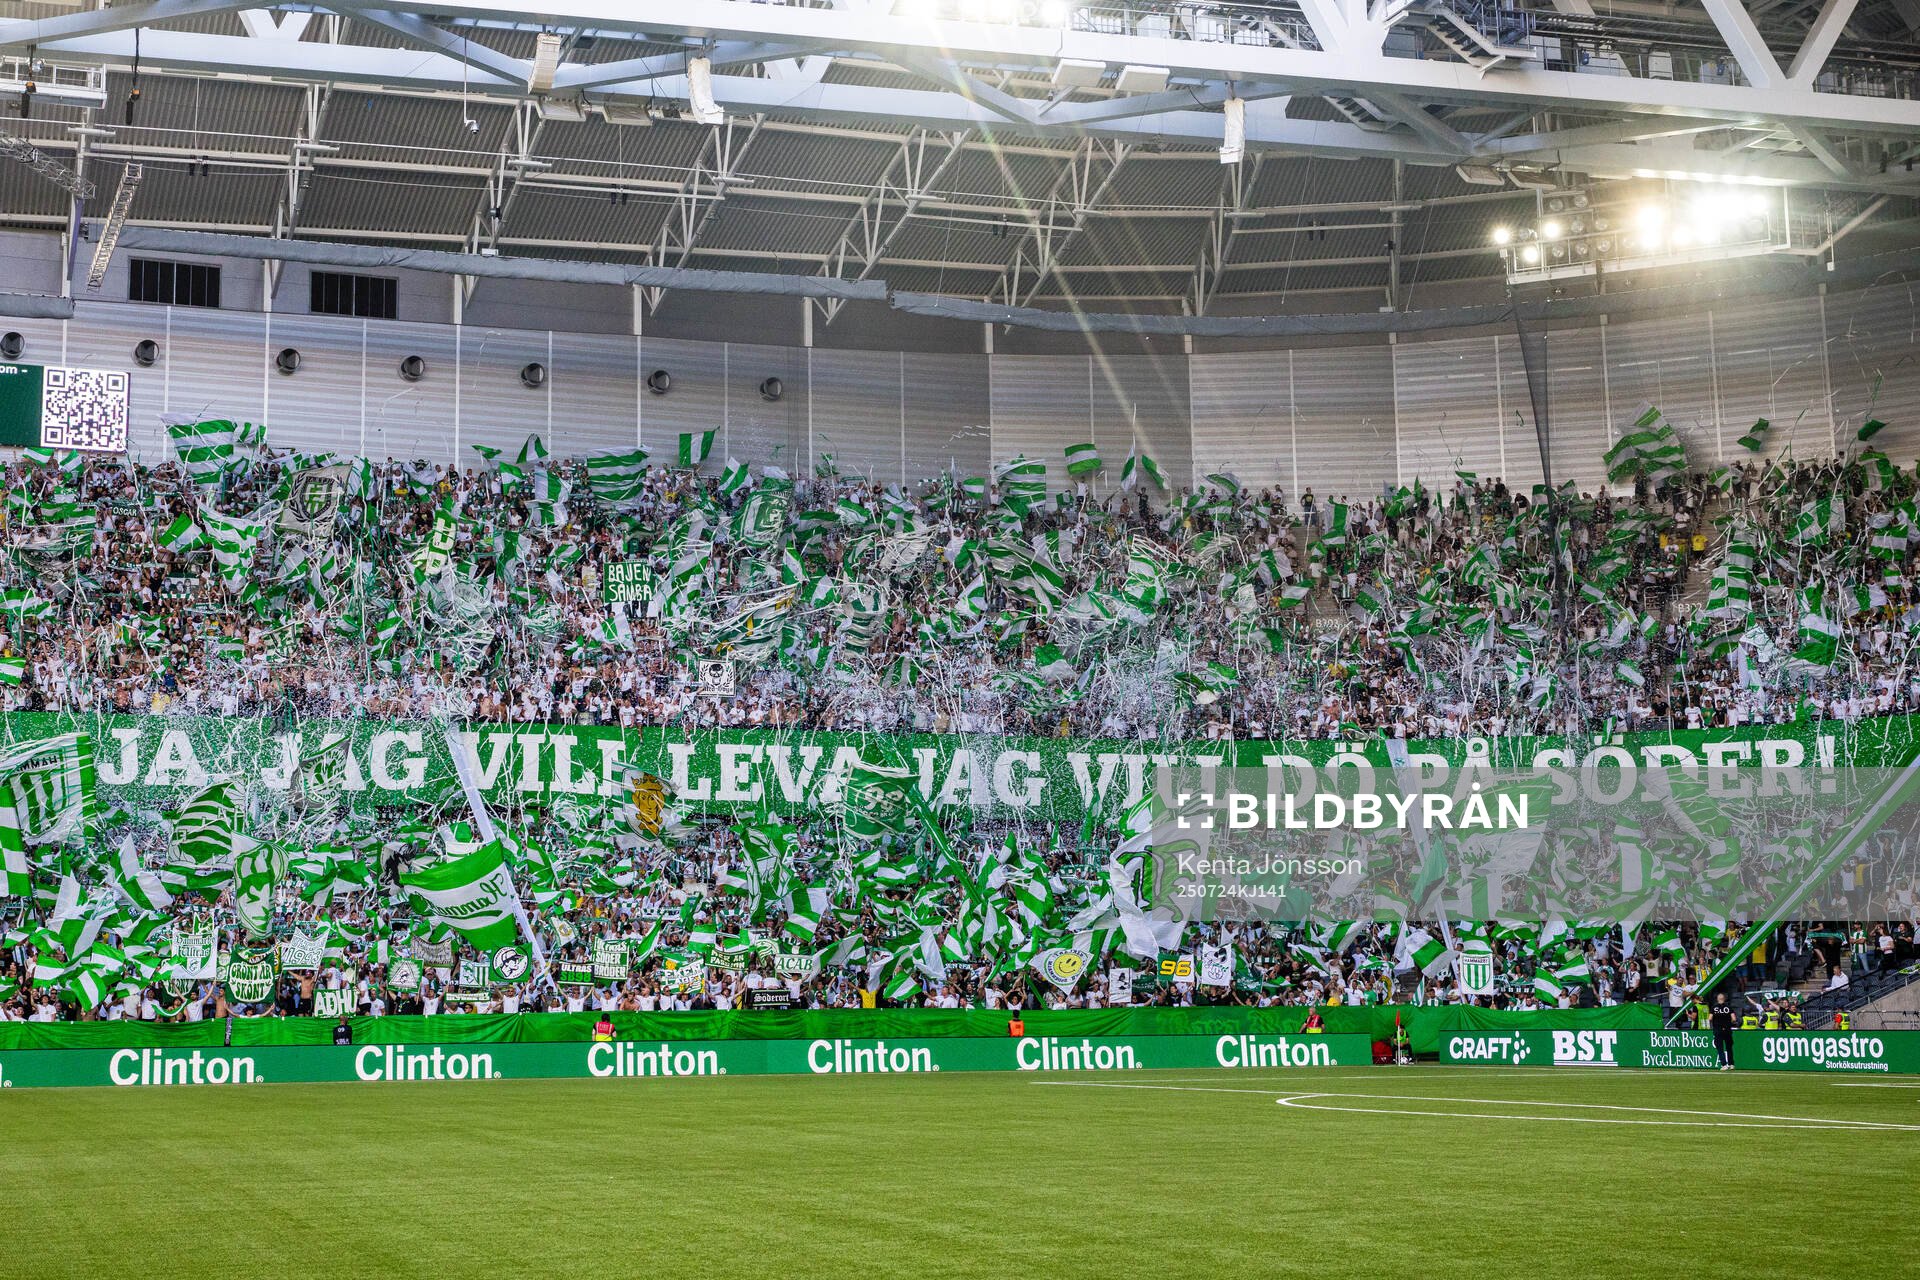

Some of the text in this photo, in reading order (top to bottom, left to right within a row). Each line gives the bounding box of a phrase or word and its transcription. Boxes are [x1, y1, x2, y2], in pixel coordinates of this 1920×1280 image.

[608, 563, 651, 582] BAJEN
[608, 584, 652, 601] SAMBA
[261, 729, 428, 791] JAG
[459, 731, 628, 798] VILL
[667, 743, 862, 803] LEVA
[912, 747, 1046, 807] JAG
[1066, 752, 1240, 809] VILL
[1262, 742, 1377, 810] DÖ
[1407, 737, 1500, 808] PÅ
[1533, 734, 1838, 806] SÖDER!
[231, 961, 259, 980] GRÖNT
[561, 963, 592, 972] ULTRAS
[776, 957, 813, 970] ACAB
[1159, 960, 1191, 976] 96
[235, 981, 265, 1000] SKÖNT
[808, 1040, 932, 1074] Clinton
[1017, 1037, 1137, 1071] Clinton
[1216, 1035, 1330, 1068] Clinton
[1449, 1037, 1511, 1059] CRAFT
[1552, 1031, 1617, 1061] BST
[110, 1049, 255, 1085] Clinton
[356, 1045, 493, 1081] Clinton
[588, 1041, 718, 1077] Clinton
[1825, 1059, 1889, 1072] Storköksutrustning
